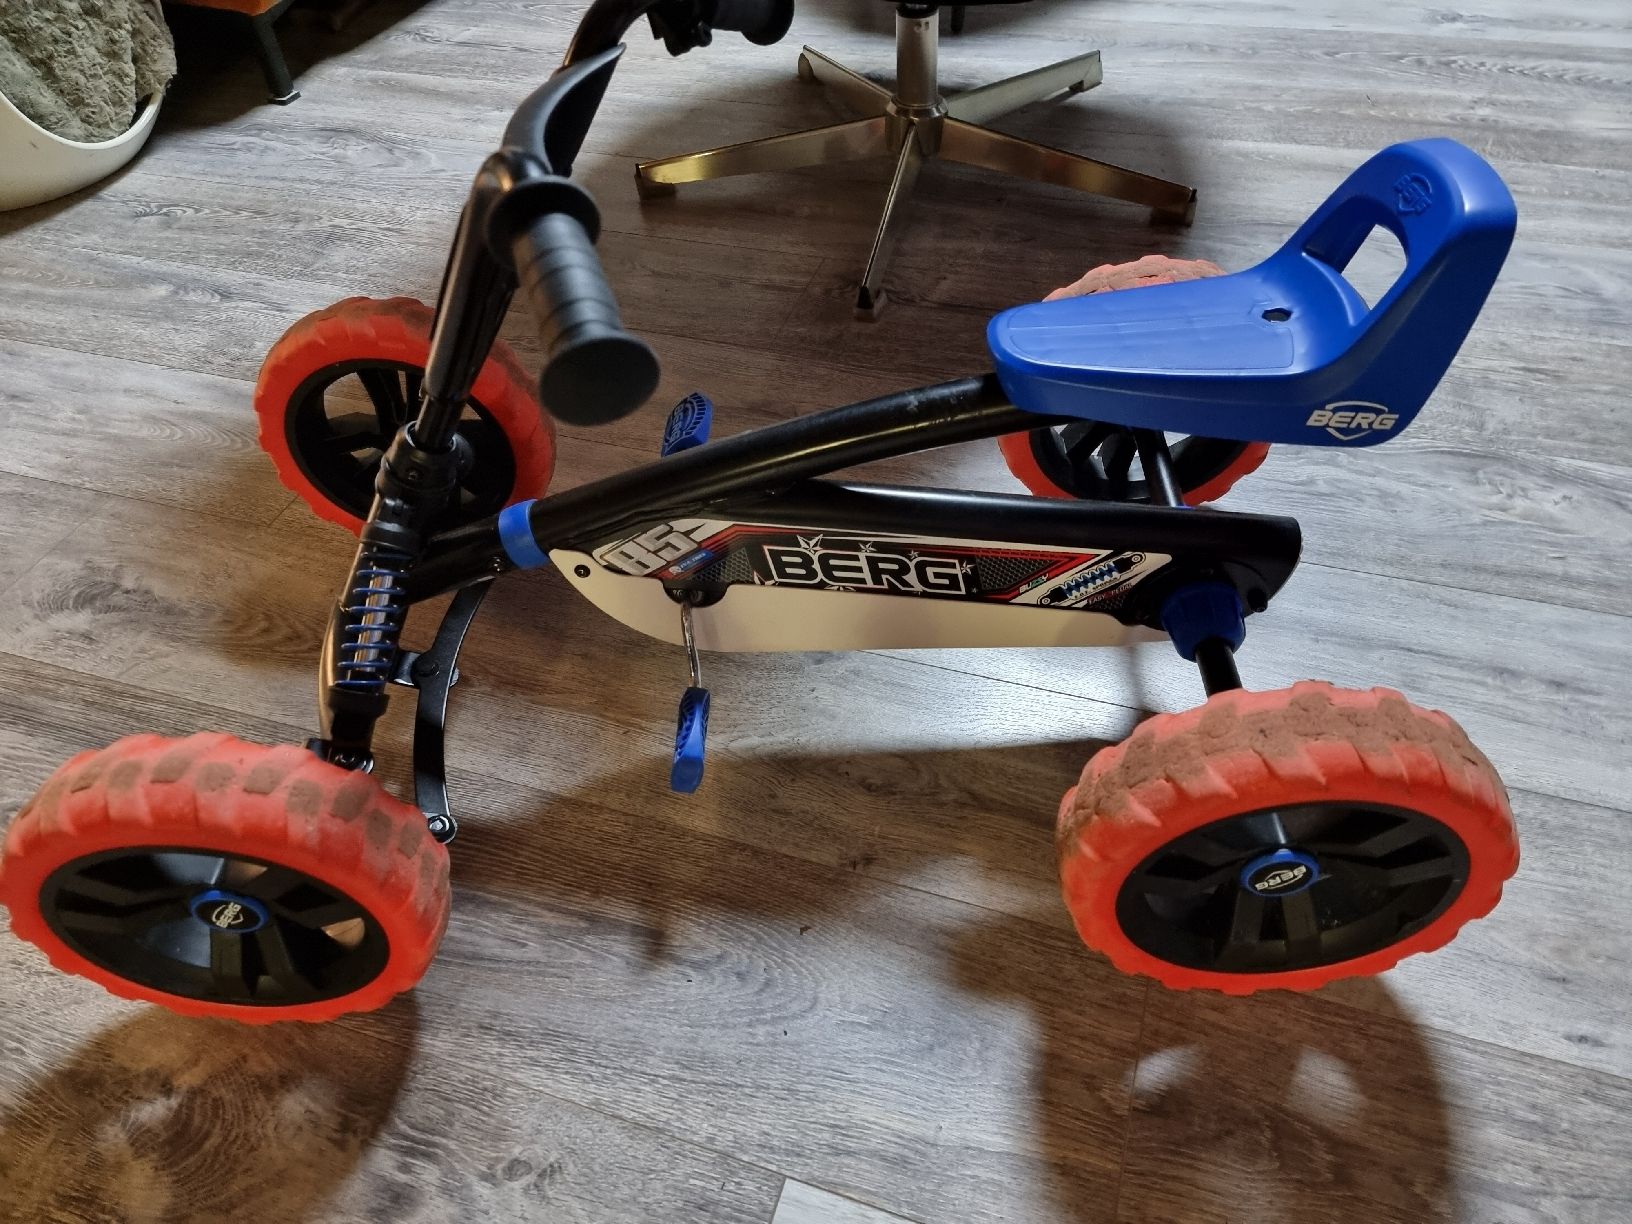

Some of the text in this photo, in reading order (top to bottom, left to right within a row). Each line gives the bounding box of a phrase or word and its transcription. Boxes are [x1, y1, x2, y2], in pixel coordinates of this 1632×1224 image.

[1305, 410, 1399, 430] BERG
[602, 523, 698, 577] 85
[763, 546, 967, 595] BERG
[1254, 865, 1307, 891] BERG
[216, 902, 242, 928] BERG
